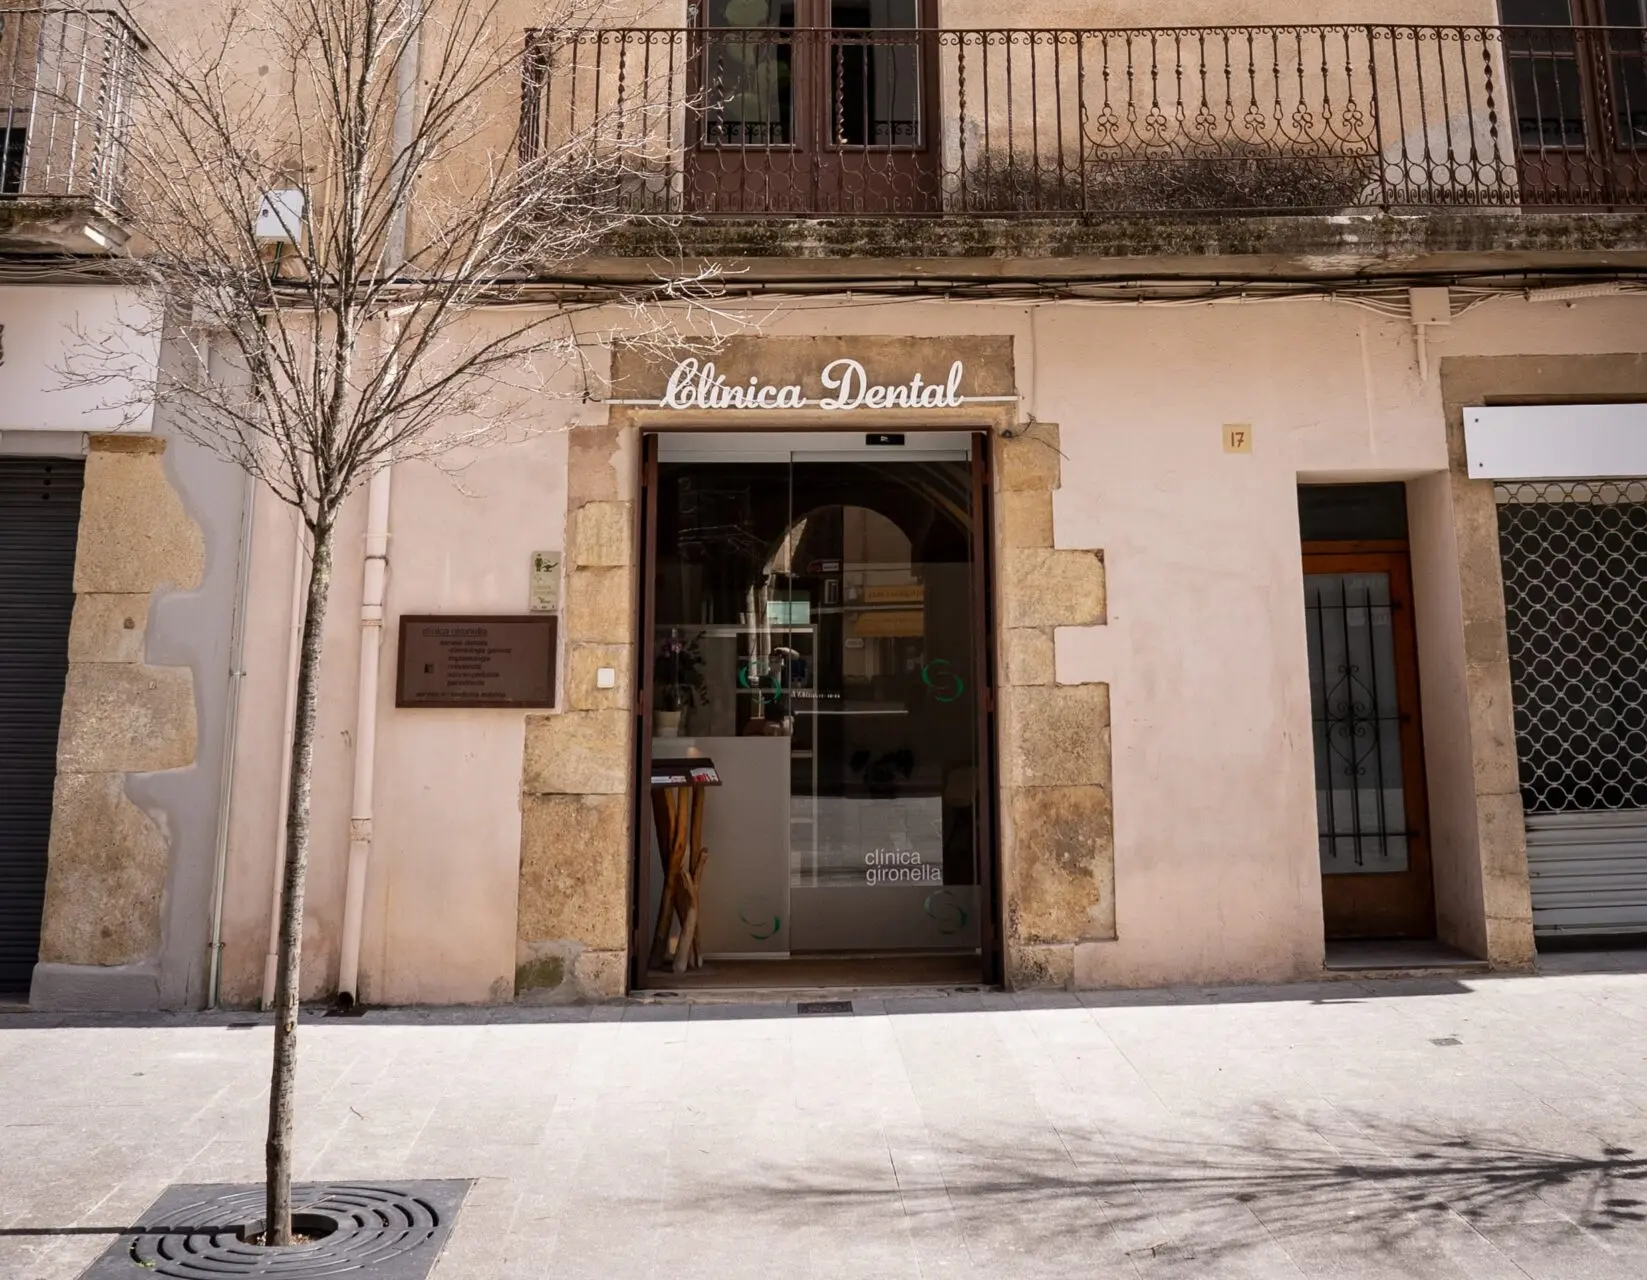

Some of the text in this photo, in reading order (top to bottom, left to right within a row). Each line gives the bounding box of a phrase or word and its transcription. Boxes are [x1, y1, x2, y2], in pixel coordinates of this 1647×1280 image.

[659, 357, 964, 410] Clínica Dental
[1231, 431, 1245, 448] 17
[865, 848, 921, 865] clínica
[866, 864, 941, 886] gironella
